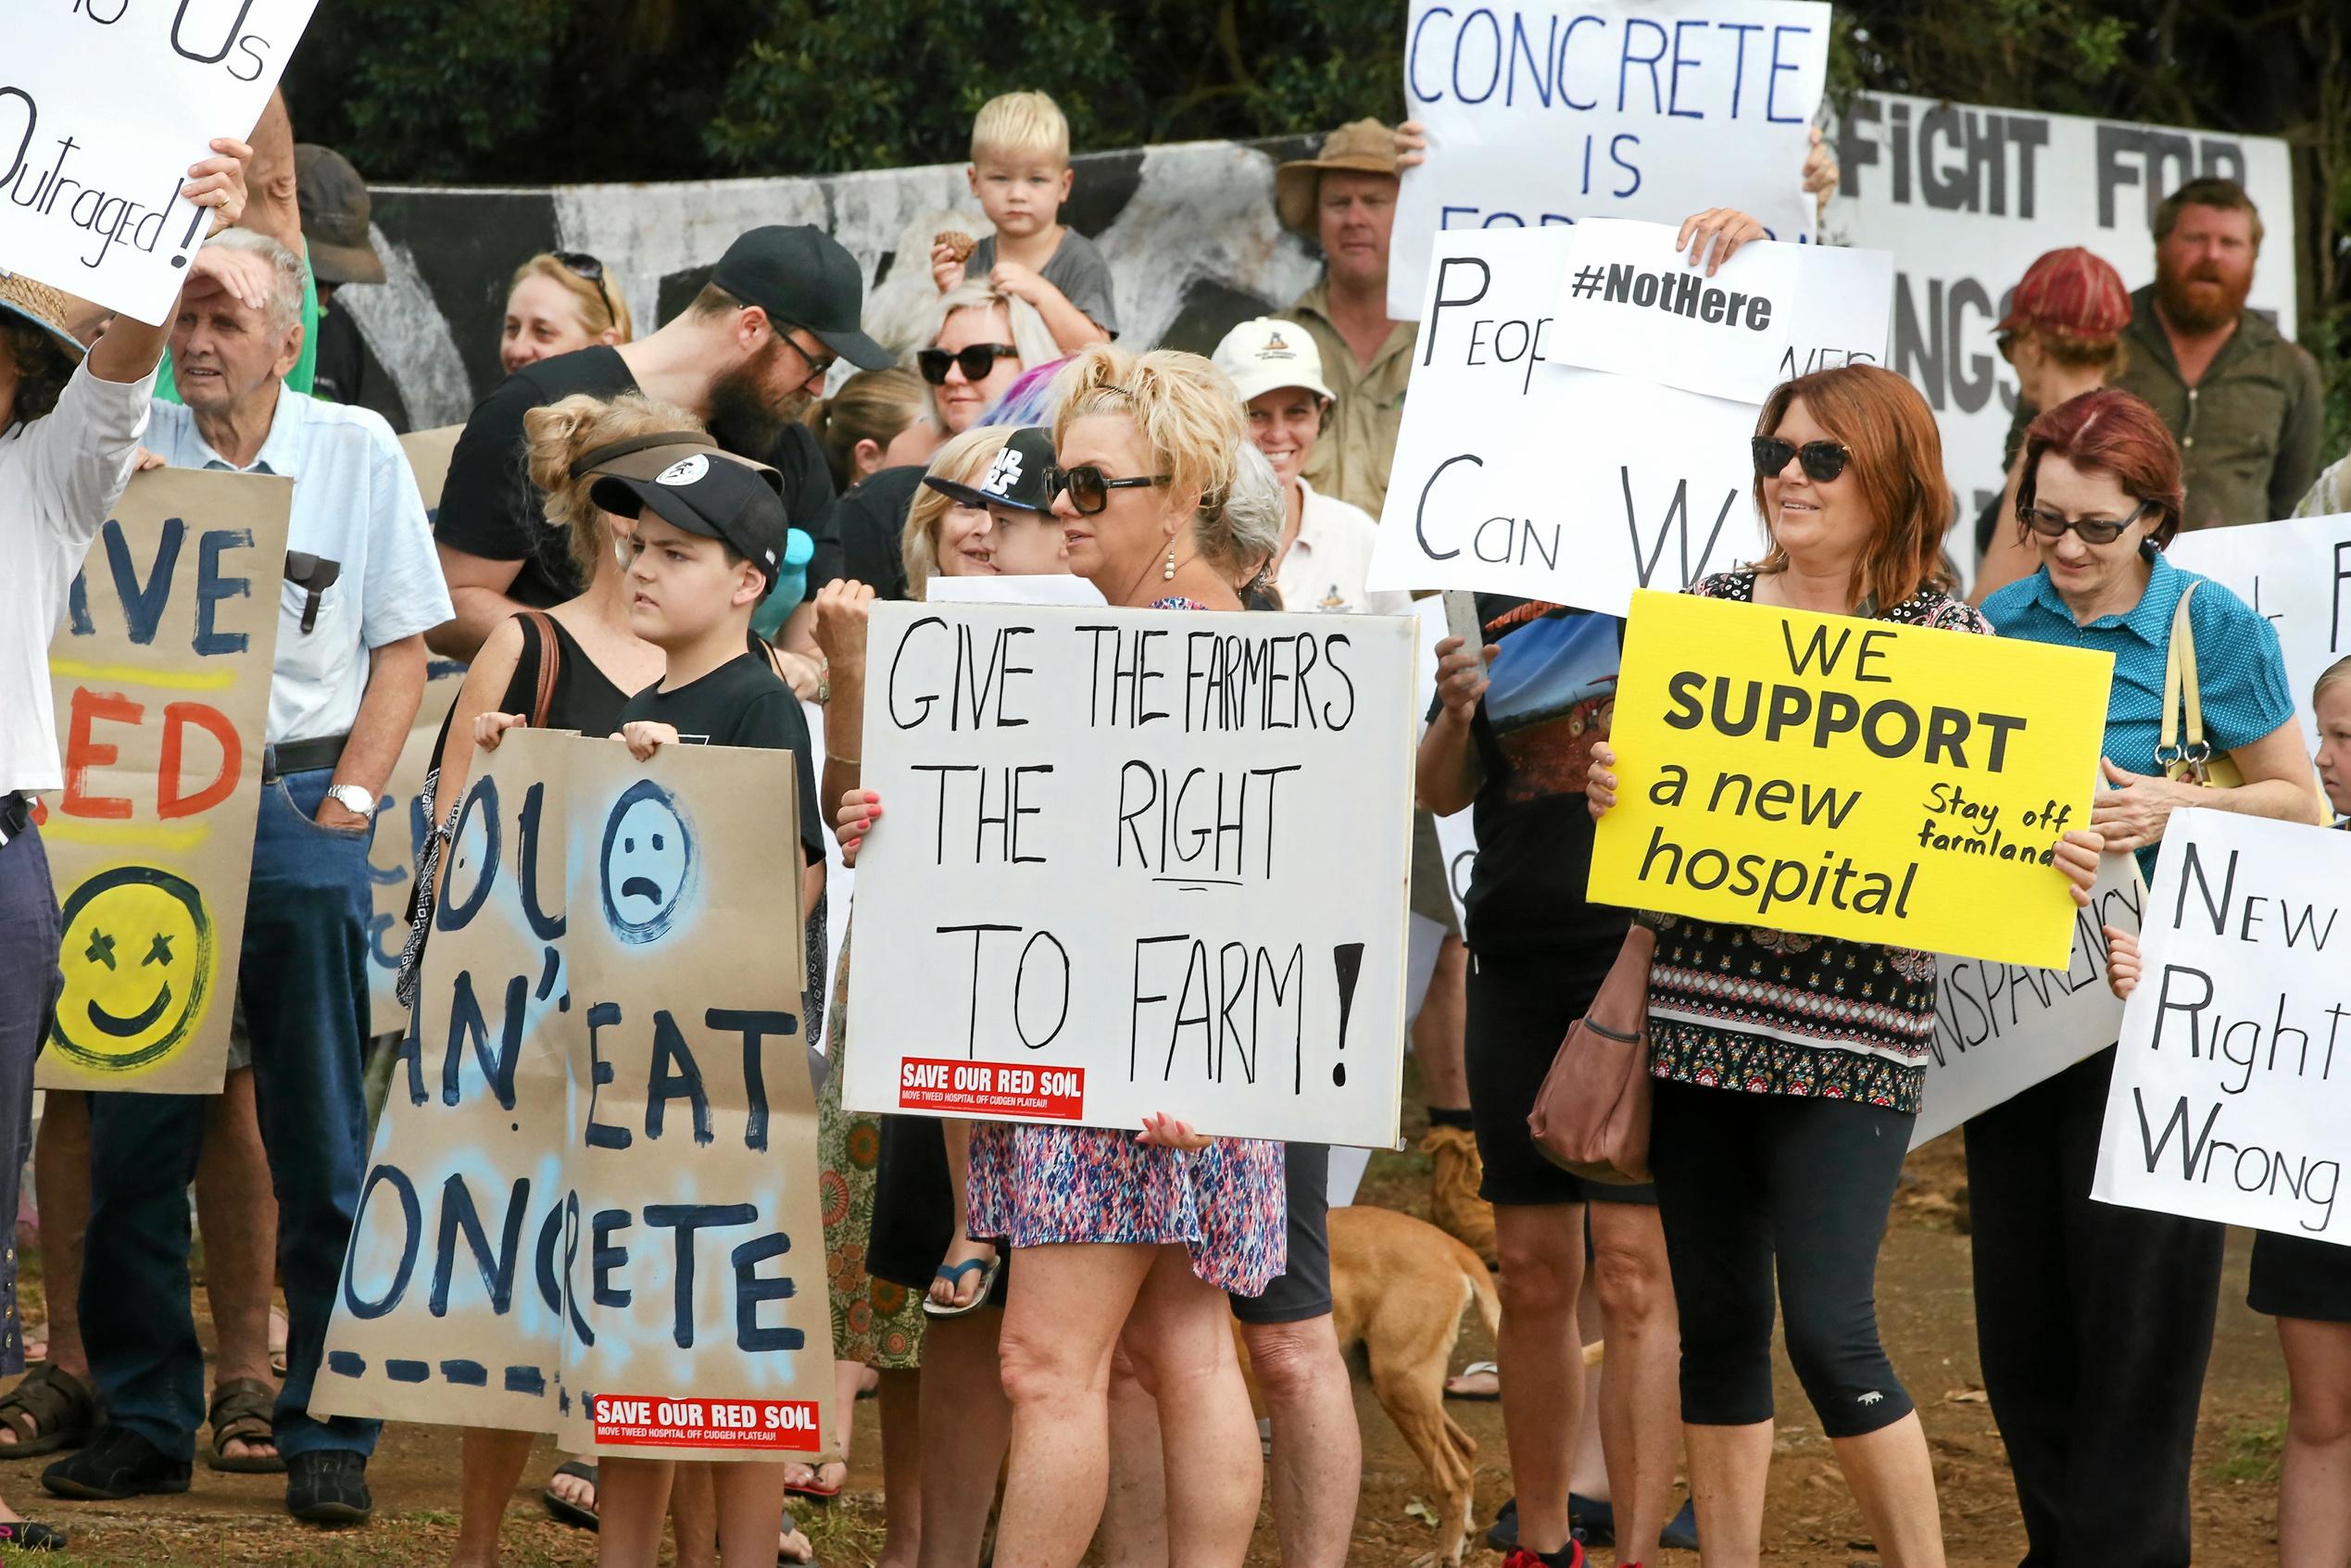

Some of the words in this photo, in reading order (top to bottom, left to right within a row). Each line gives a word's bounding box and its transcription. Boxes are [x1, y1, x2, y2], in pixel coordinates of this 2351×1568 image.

[1410, 7, 1811, 123] CONCRETE
[1581, 133, 1641, 198] IS
[1572, 263, 1772, 332] #NotHere
[889, 617, 1034, 731] GIVE
[1075, 626, 1169, 728] THE
[1187, 632, 1354, 732] FARMERS
[1781, 619, 1897, 684] WE
[31, 685, 242, 822] ED
[1663, 671, 2027, 773] SUPPORT
[911, 764, 1053, 865] THE
[1117, 759, 1301, 879] RIGHT
[1649, 764, 1689, 807] a
[1707, 771, 1862, 830] new
[1922, 783, 1999, 835] Stay
[2022, 799, 2072, 834] off
[1638, 826, 1918, 919] hospital
[1917, 818, 2057, 867] farmland
[937, 924, 1070, 1060] TO
[2152, 964, 2351, 1095] Right
[585, 1001, 798, 1154] EAT
[901, 1090, 921, 1099] MOVE
[921, 1091, 943, 1101] TWEED
[945, 1093, 975, 1104] HOSPITAL
[976, 1095, 989, 1104] OFF
[989, 1096, 1016, 1106] CUDGEN
[1017, 1098, 1048, 1109] PLATEAU!
[902, 1062, 949, 1089] SAVE
[954, 1066, 992, 1092] OUR
[998, 1069, 1035, 1095] RED
[1040, 1071, 1081, 1099] SOIL
[596, 1399, 651, 1425] SAVE
[658, 1402, 704, 1427] OUR
[711, 1404, 758, 1429] RED
[764, 1404, 816, 1432] SOIL
[597, 1426, 621, 1436] MOVE
[621, 1427, 647, 1437] TWEED
[648, 1428, 685, 1439] HOSPITAL
[687, 1429, 702, 1439] OFF
[704, 1430, 736, 1440] CUDGEN
[737, 1431, 777, 1442] PLATEAU!
